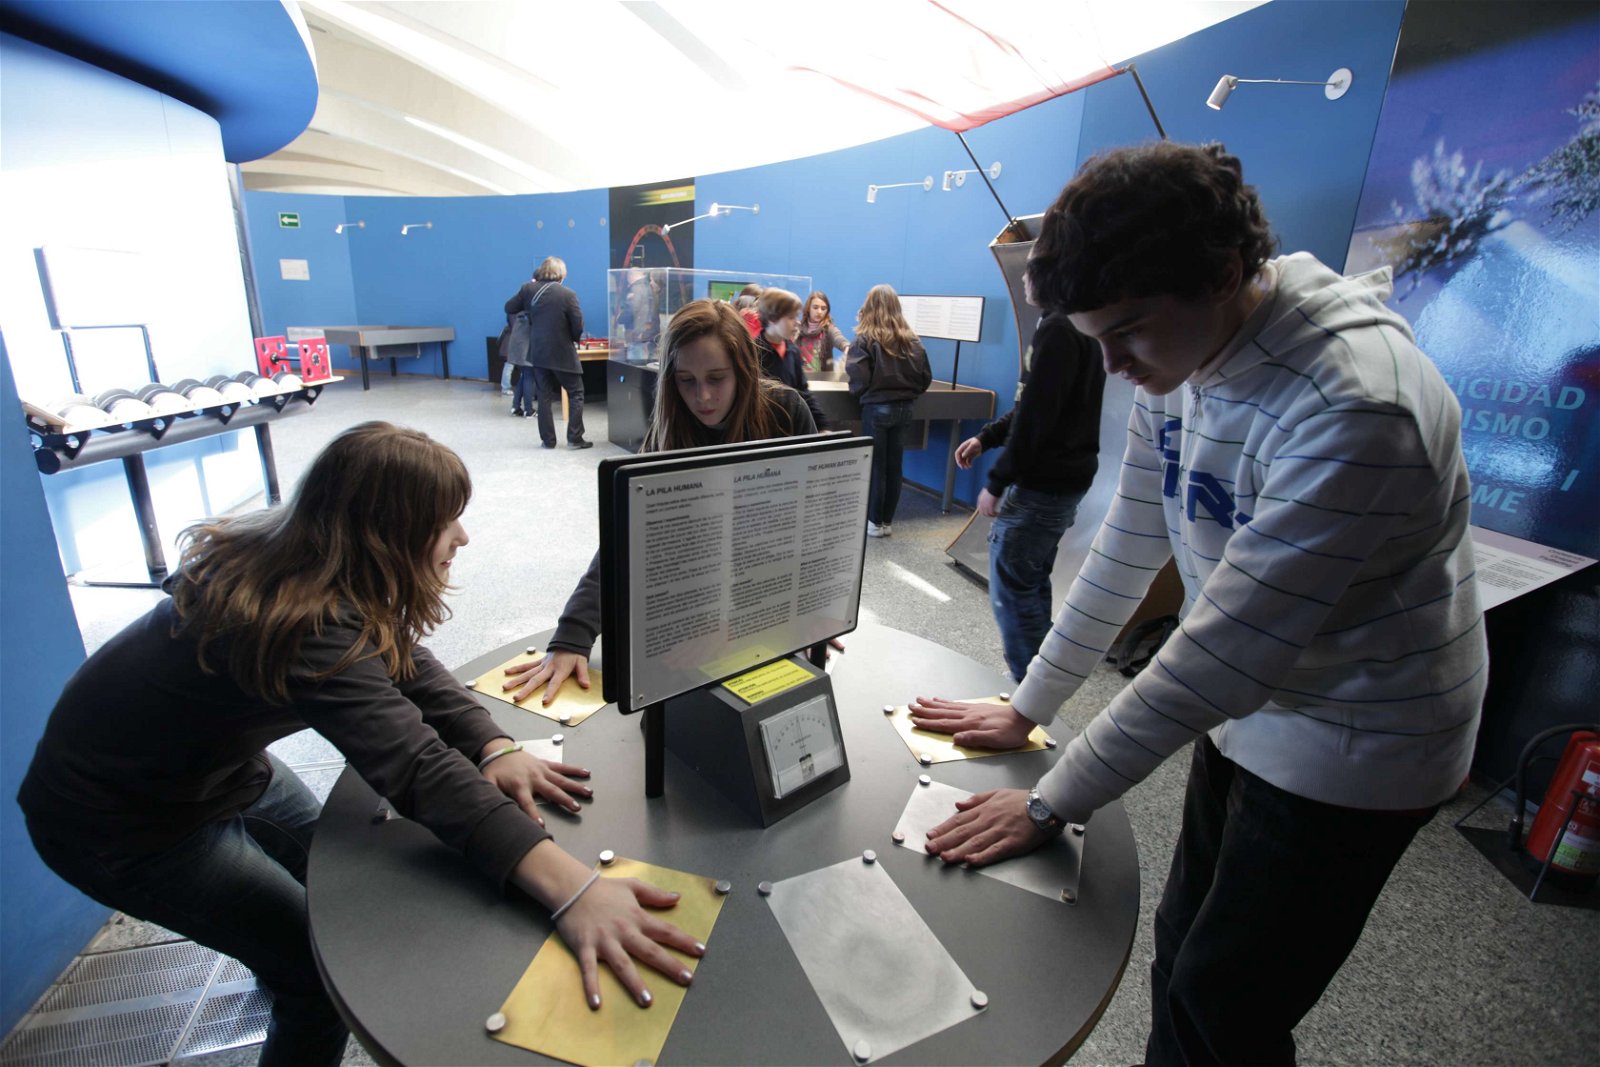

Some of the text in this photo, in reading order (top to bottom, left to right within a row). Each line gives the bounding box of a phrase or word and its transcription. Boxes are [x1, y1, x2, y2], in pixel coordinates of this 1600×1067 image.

[1446, 374, 1586, 411] ICIDAD
[1461, 408, 1550, 440] ISMO
[837, 459, 858, 468] BATTERY
[743, 474, 756, 482] PILA
[756, 470, 781, 480] HUMANA
[645, 481, 704, 497] LA PILA HUMANA
[1471, 483, 1526, 514] ME
